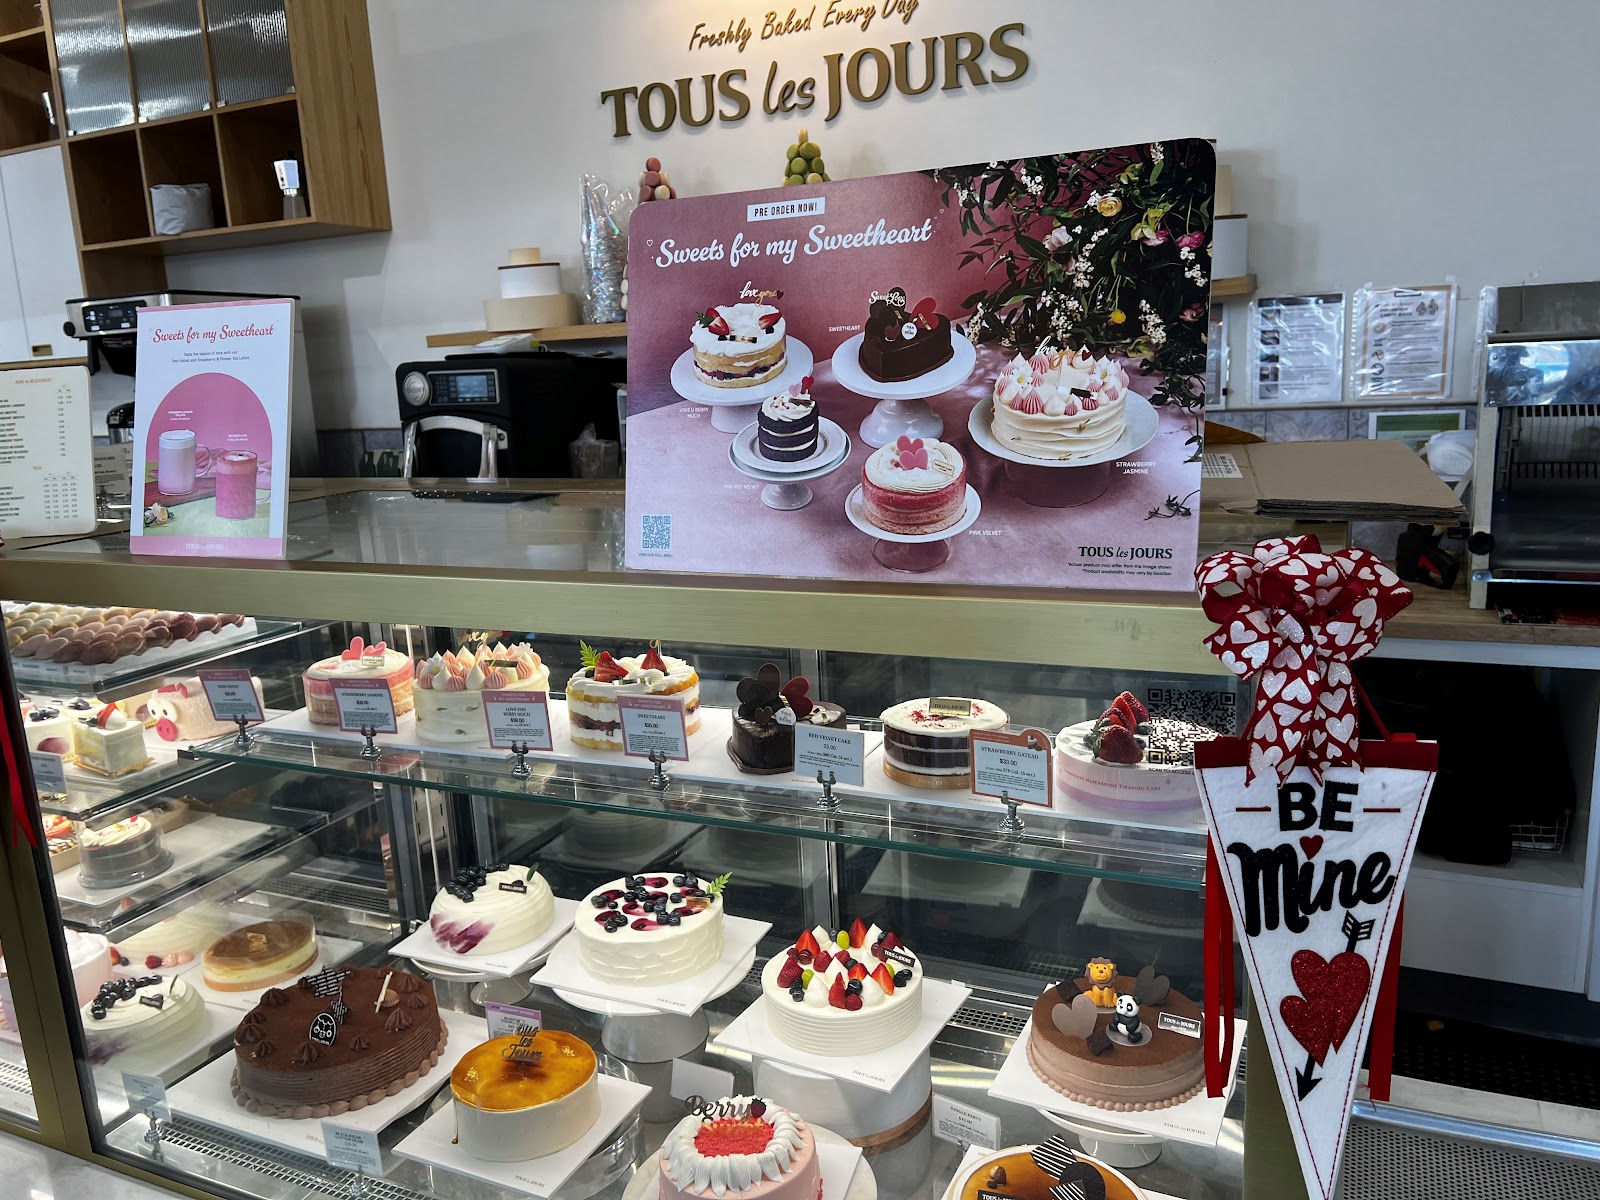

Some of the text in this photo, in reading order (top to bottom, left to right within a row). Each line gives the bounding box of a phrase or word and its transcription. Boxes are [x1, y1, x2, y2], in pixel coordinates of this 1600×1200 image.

[689, 0, 919, 53] Freshly Baked Every Day
[601, 22, 1030, 138] TOUS les JOURS
[754, 202, 818, 217] PRE ORDER NOW!
[655, 218, 932, 268] Sweets for my Sweetheart
[152, 323, 274, 344] Sweets for my Sweetheart
[1078, 546, 1173, 560] TOUS les JOURS
[981, 746, 1039, 760] STRAWBERRY GATEAU
[1086, 778, 1117, 788] MASCARPONE
[1277, 779, 1359, 832] BE
[1226, 842, 1396, 938] Mine
[685, 1095, 751, 1122] Berry
